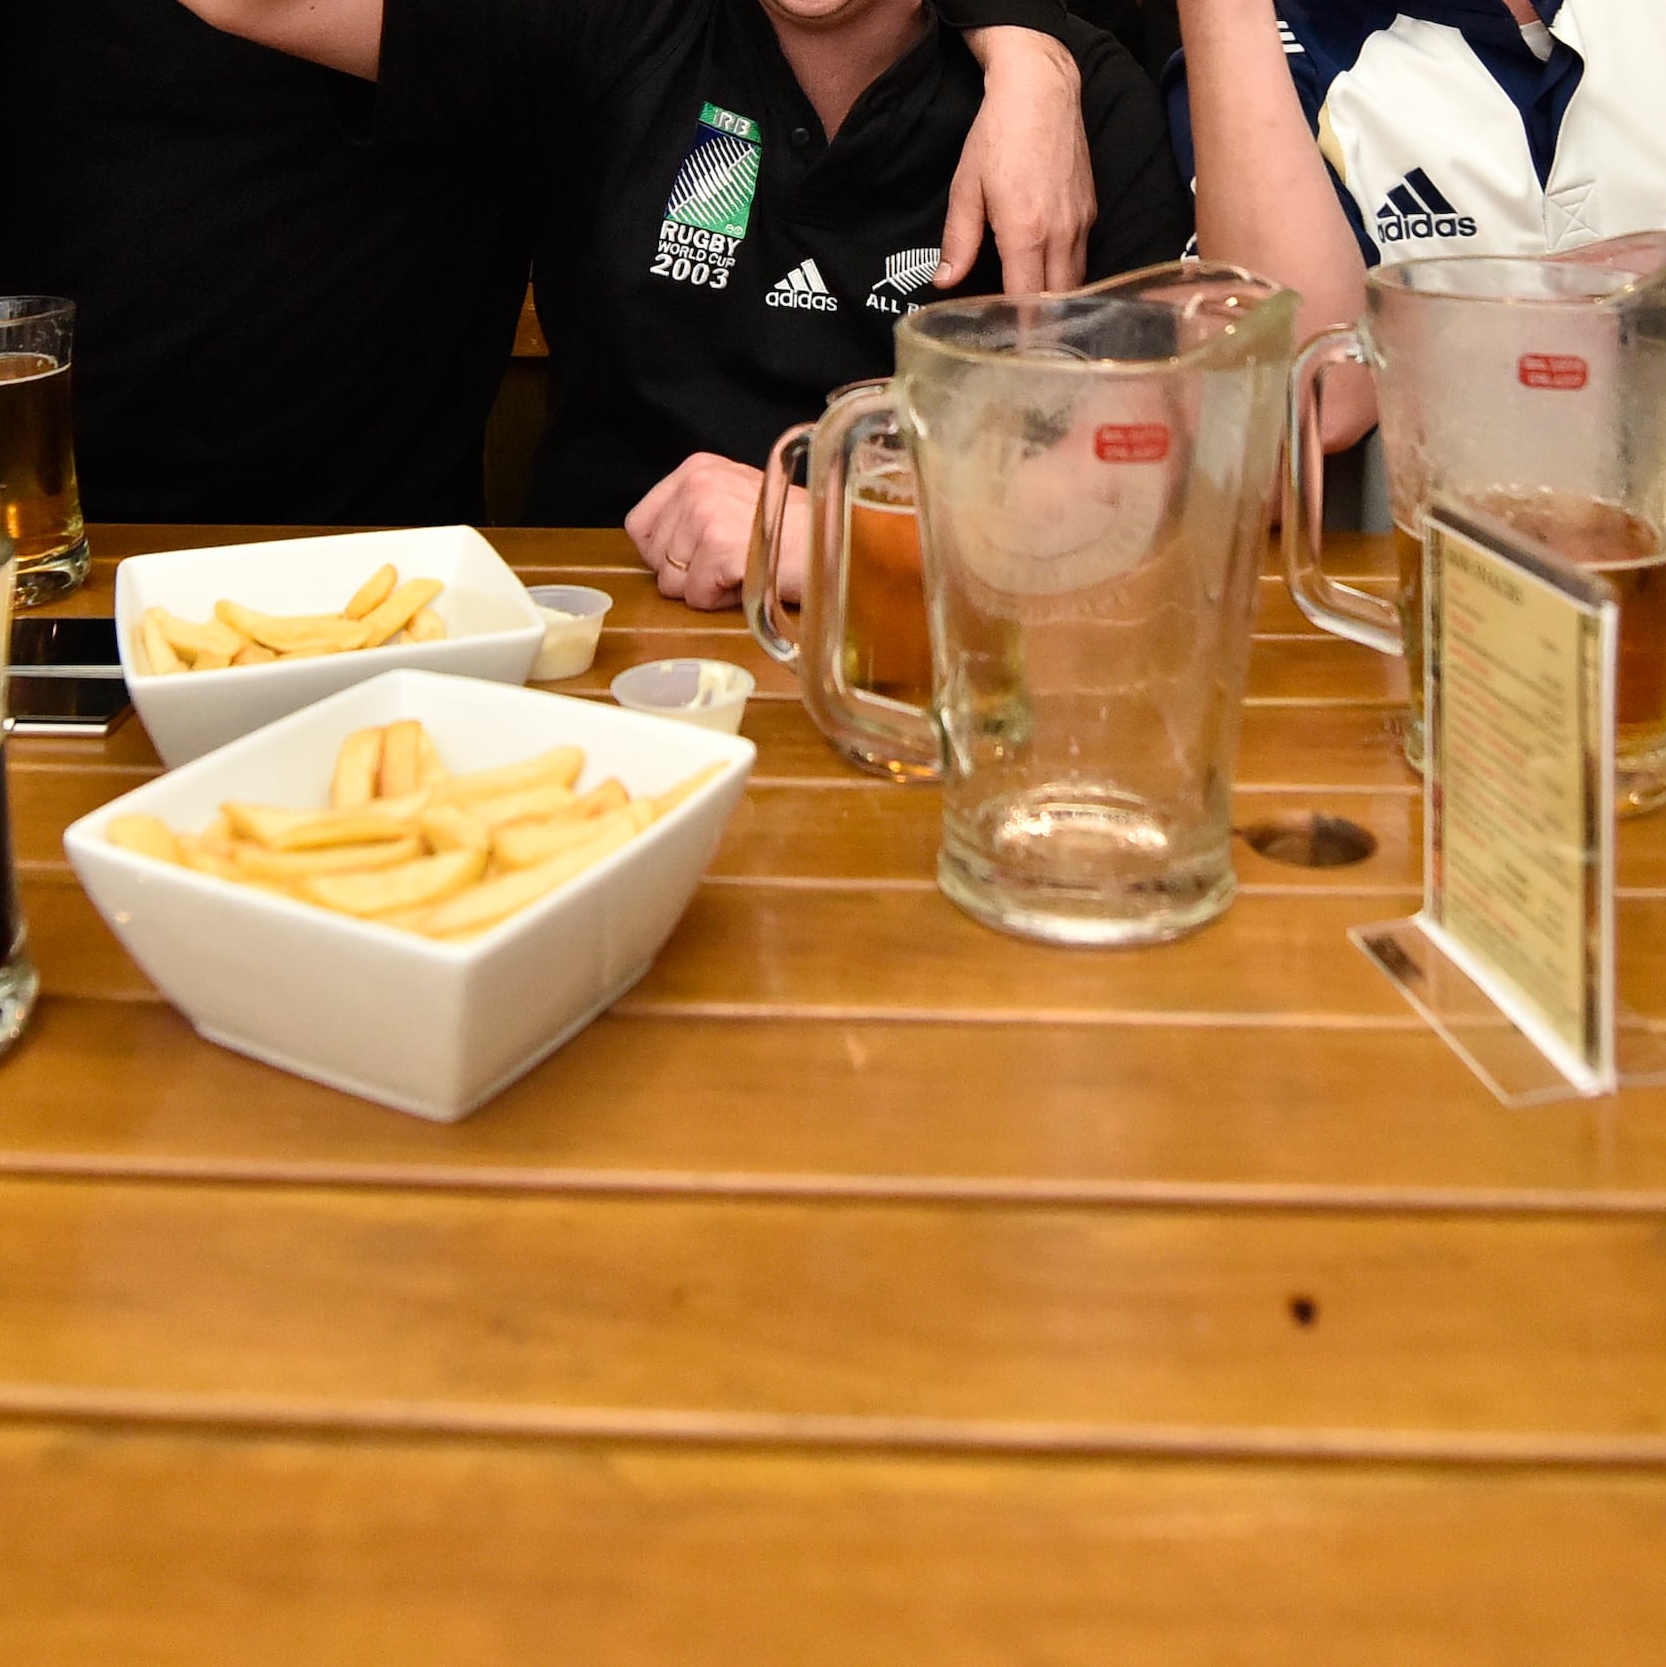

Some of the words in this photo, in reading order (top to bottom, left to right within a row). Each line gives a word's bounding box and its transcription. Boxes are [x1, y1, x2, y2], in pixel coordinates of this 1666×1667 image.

[659, 219, 743, 257] RUGBY
[657, 239, 707, 263] WORLD
[708, 252, 737, 269] CUP
[649, 253, 730, 291] 2003
[765, 290, 839, 313] adidas
[865, 293, 902, 315] ALL
